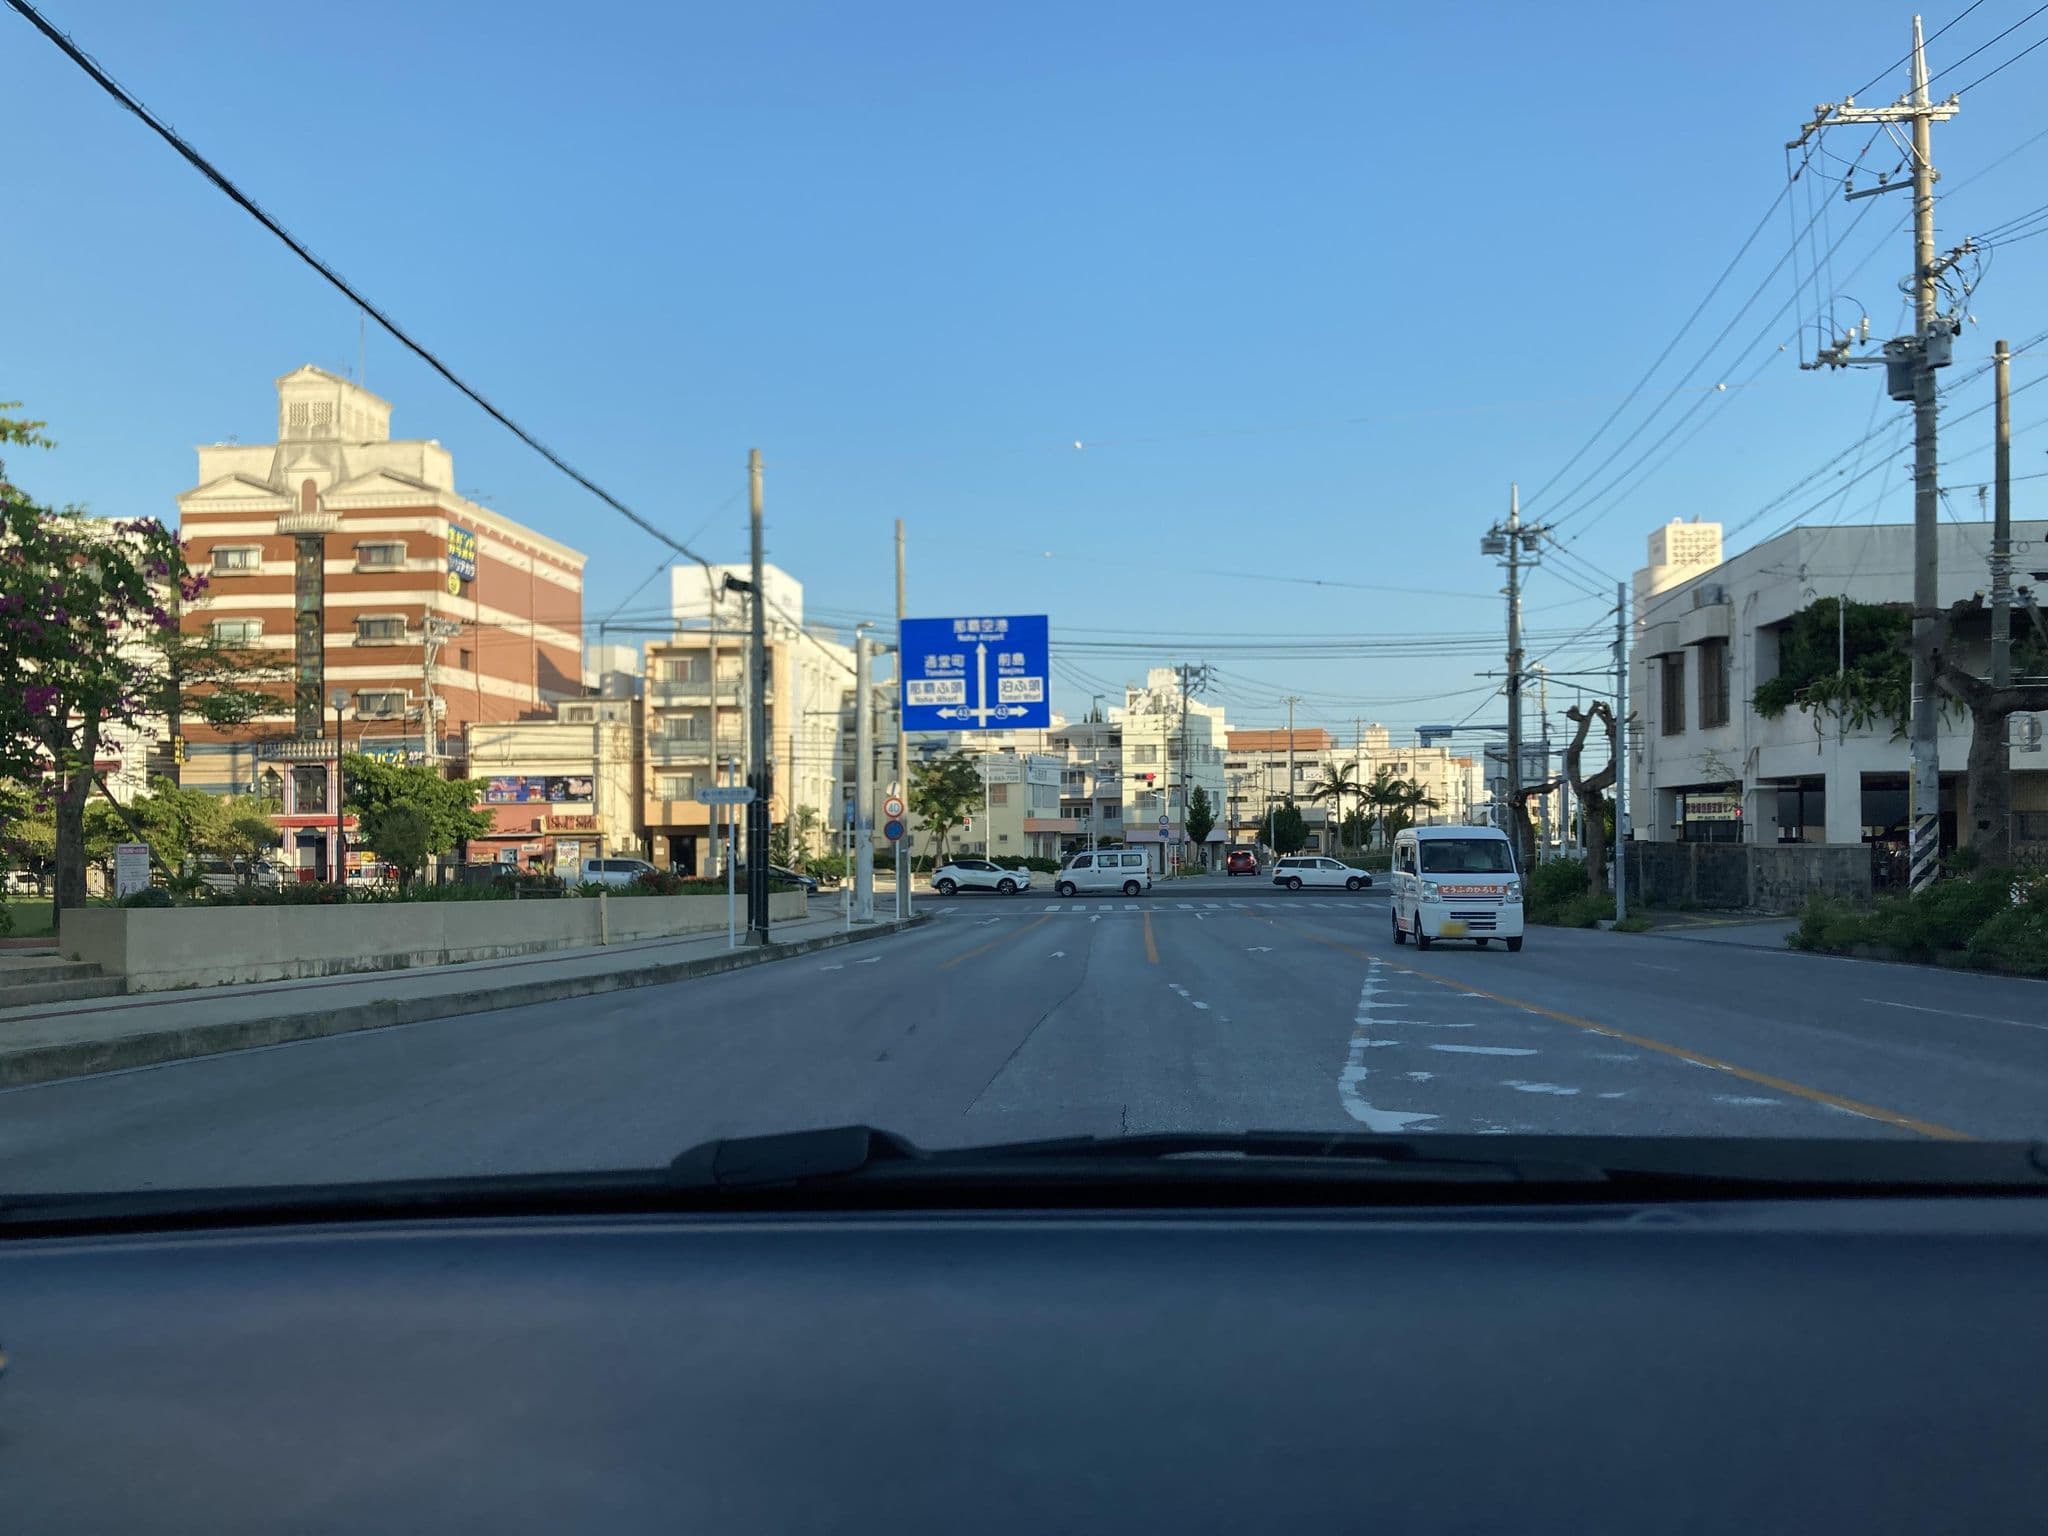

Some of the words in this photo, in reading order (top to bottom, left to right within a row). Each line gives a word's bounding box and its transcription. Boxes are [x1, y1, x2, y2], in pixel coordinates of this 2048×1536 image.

[953, 619, 1008, 633] 那覇空港
[957, 634, 976, 642] Naha
[979, 633, 1004, 643] Airport
[924, 654, 965, 668] 通堂町
[998, 652, 1025, 666] 前島
[910, 682, 962, 695] 那覇ふ頭
[1001, 679, 1040, 692] 泊ふ頭
[936, 695, 957, 703] Wharf
[958, 708, 968, 717] 43
[998, 706, 1007, 715] 43
[888, 803, 899, 813] 40
